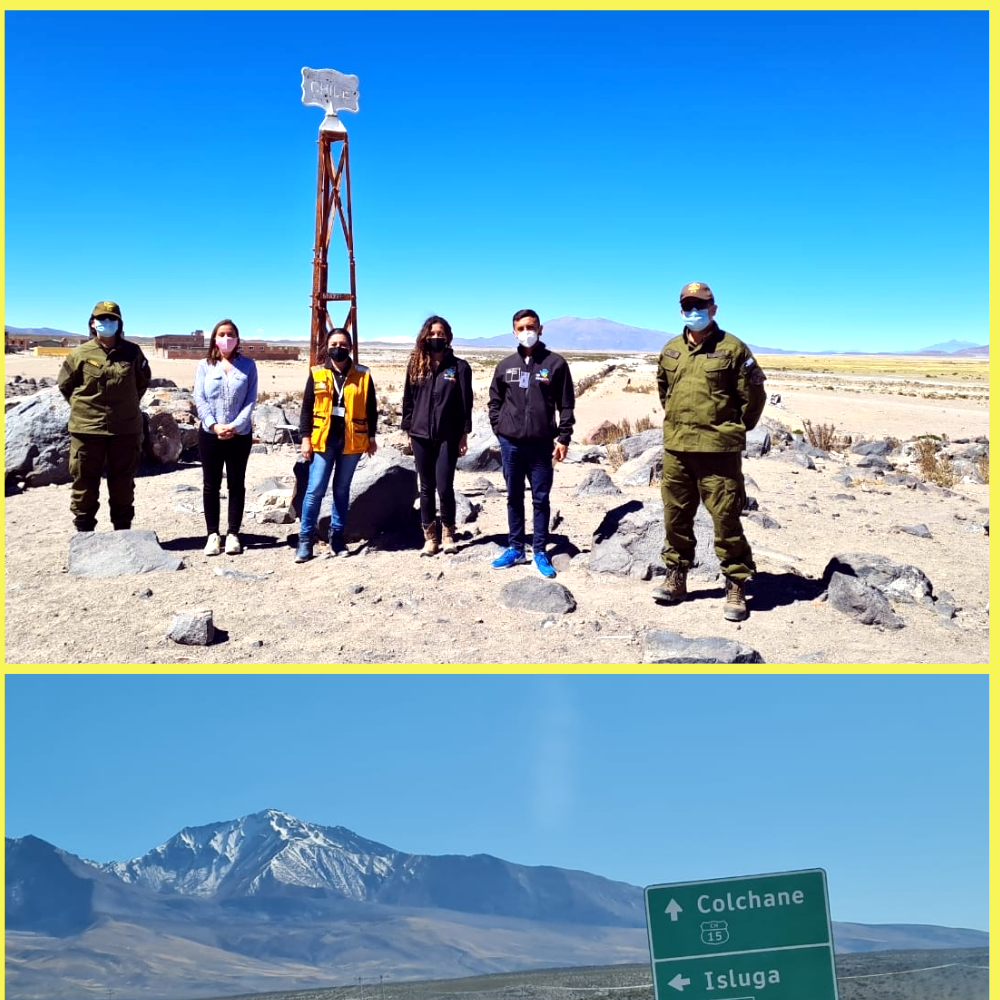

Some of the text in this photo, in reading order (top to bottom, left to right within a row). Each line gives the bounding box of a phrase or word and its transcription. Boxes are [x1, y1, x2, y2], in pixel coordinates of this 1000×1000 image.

[311, 81, 350, 99] CHILE
[697, 890, 804, 914] Colchane
[707, 931, 722, 942] 15
[704, 969, 780, 991] Isluga
